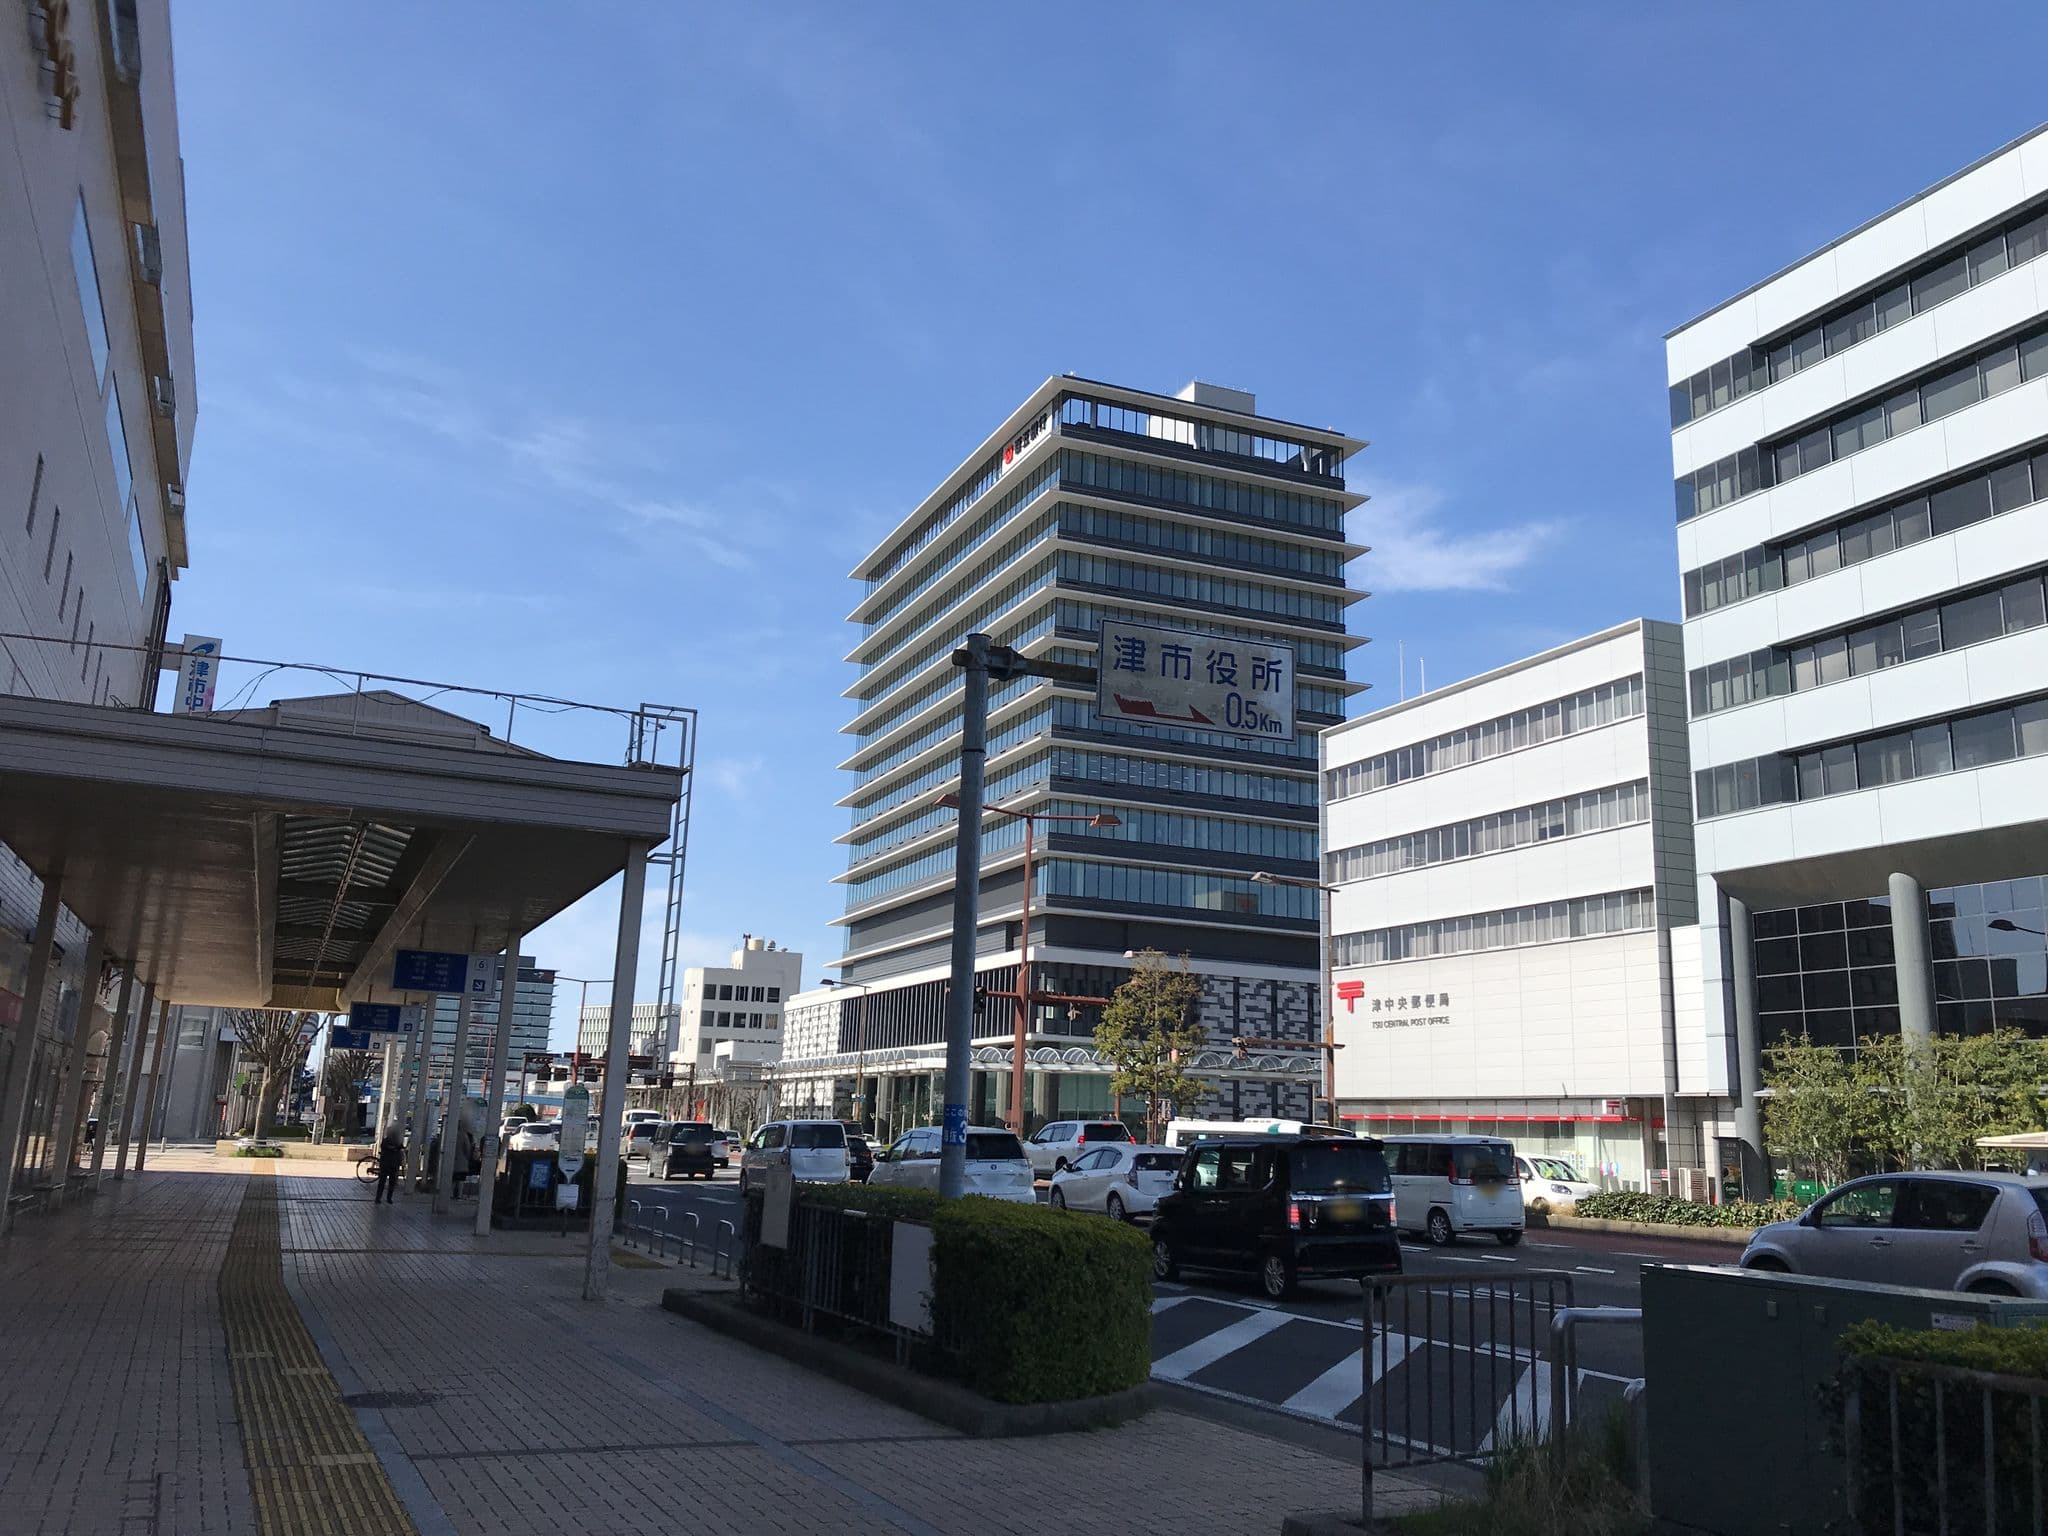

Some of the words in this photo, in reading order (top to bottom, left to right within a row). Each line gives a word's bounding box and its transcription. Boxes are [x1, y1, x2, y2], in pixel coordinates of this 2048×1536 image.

[1113, 634, 1282, 693] 津市役所
[478, 960, 485, 970] 6
[1371, 992, 1450, 1013] 津中央郵便局
[1372, 1020, 1384, 1029] TSU
[1383, 1018, 1410, 1029] CENTRAL
[1410, 1017, 1427, 1027] POST
[1427, 1015, 1450, 1026] OFFICE
